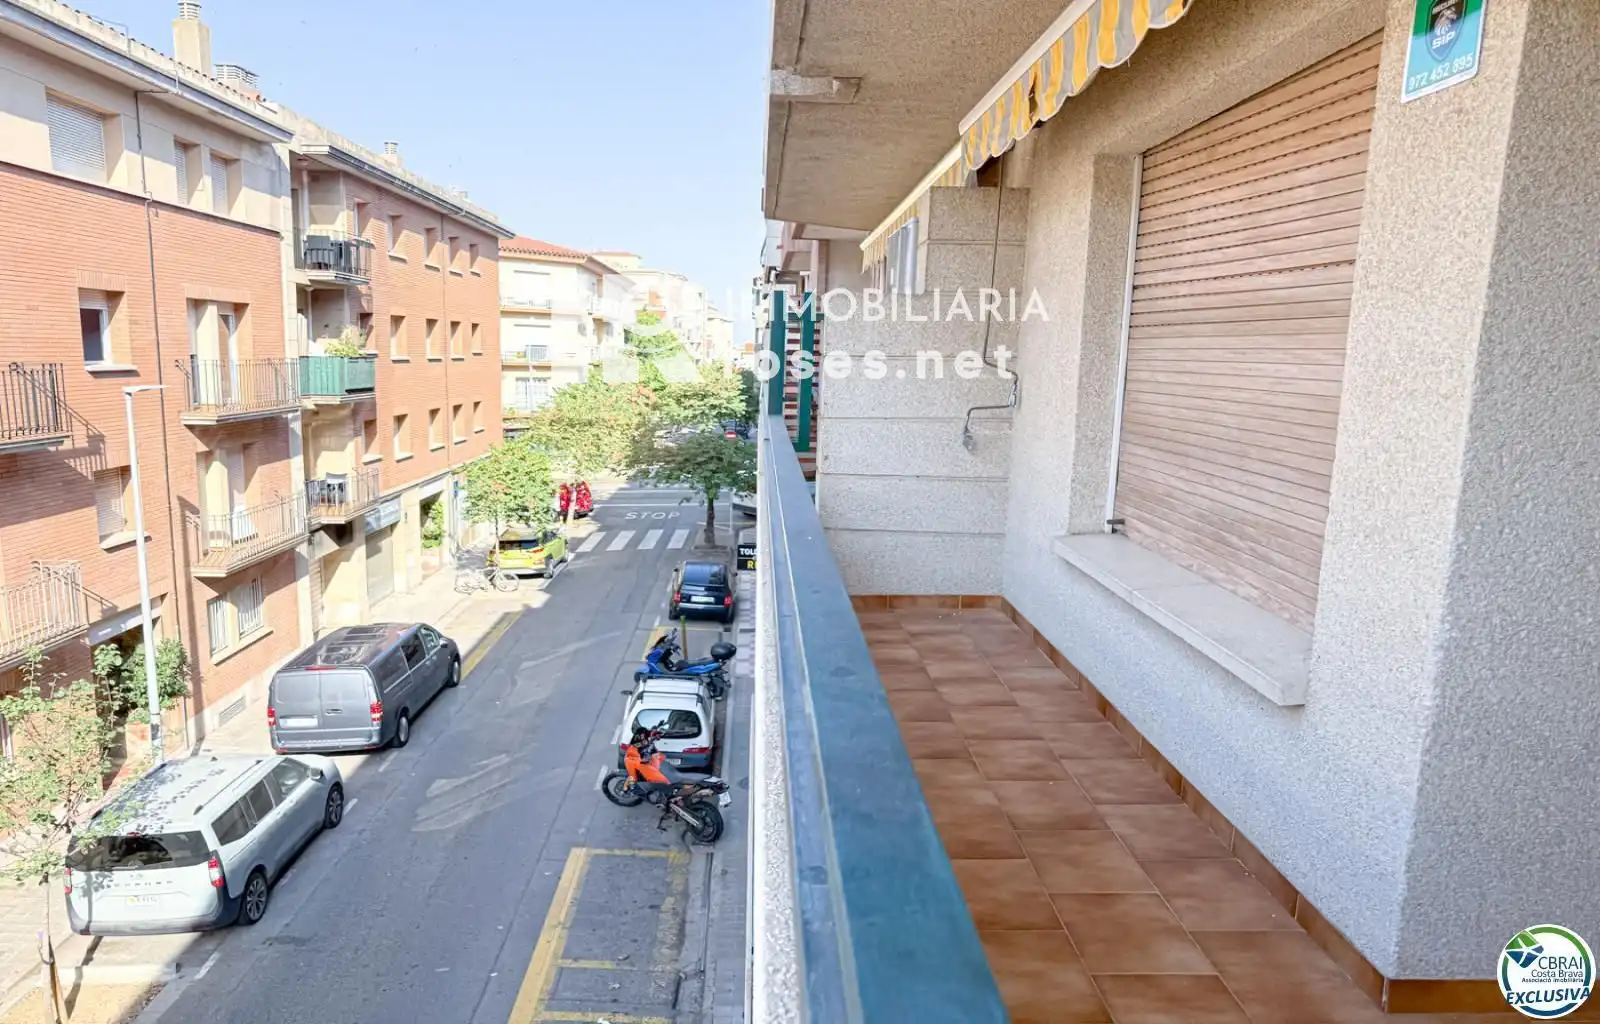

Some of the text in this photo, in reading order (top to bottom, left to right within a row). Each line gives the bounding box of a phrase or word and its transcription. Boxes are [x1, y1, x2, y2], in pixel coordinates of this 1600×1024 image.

[1432, 31, 1456, 50] SIP
[1407, 71, 1429, 91] 972
[1430, 62, 1450, 80] 452
[624, 511, 681, 520] STOP
[740, 547, 757, 556] TOL
